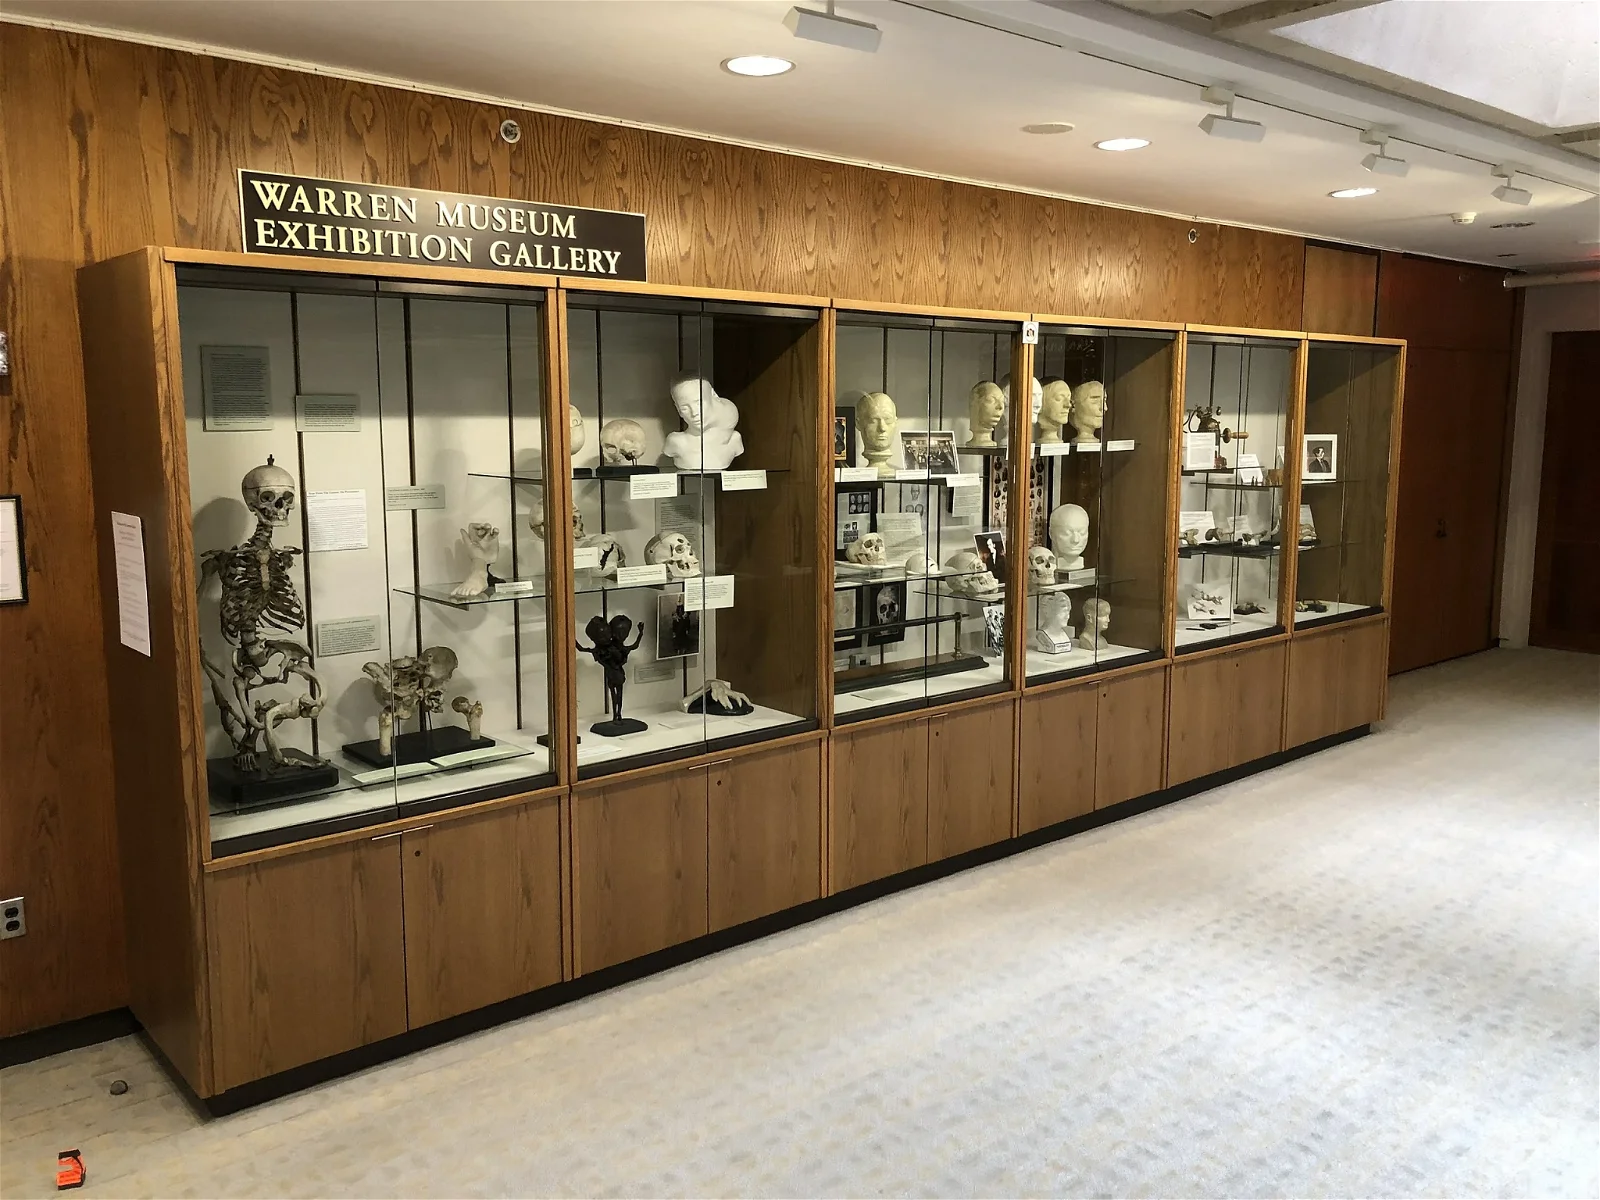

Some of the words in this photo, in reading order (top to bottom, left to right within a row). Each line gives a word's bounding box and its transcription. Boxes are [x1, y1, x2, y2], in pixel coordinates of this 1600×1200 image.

[250, 180, 417, 222] WARREN
[436, 201, 577, 239] MUSEUM
[254, 219, 473, 263] EXHIBITION
[489, 240, 622, 275] GALLERY
